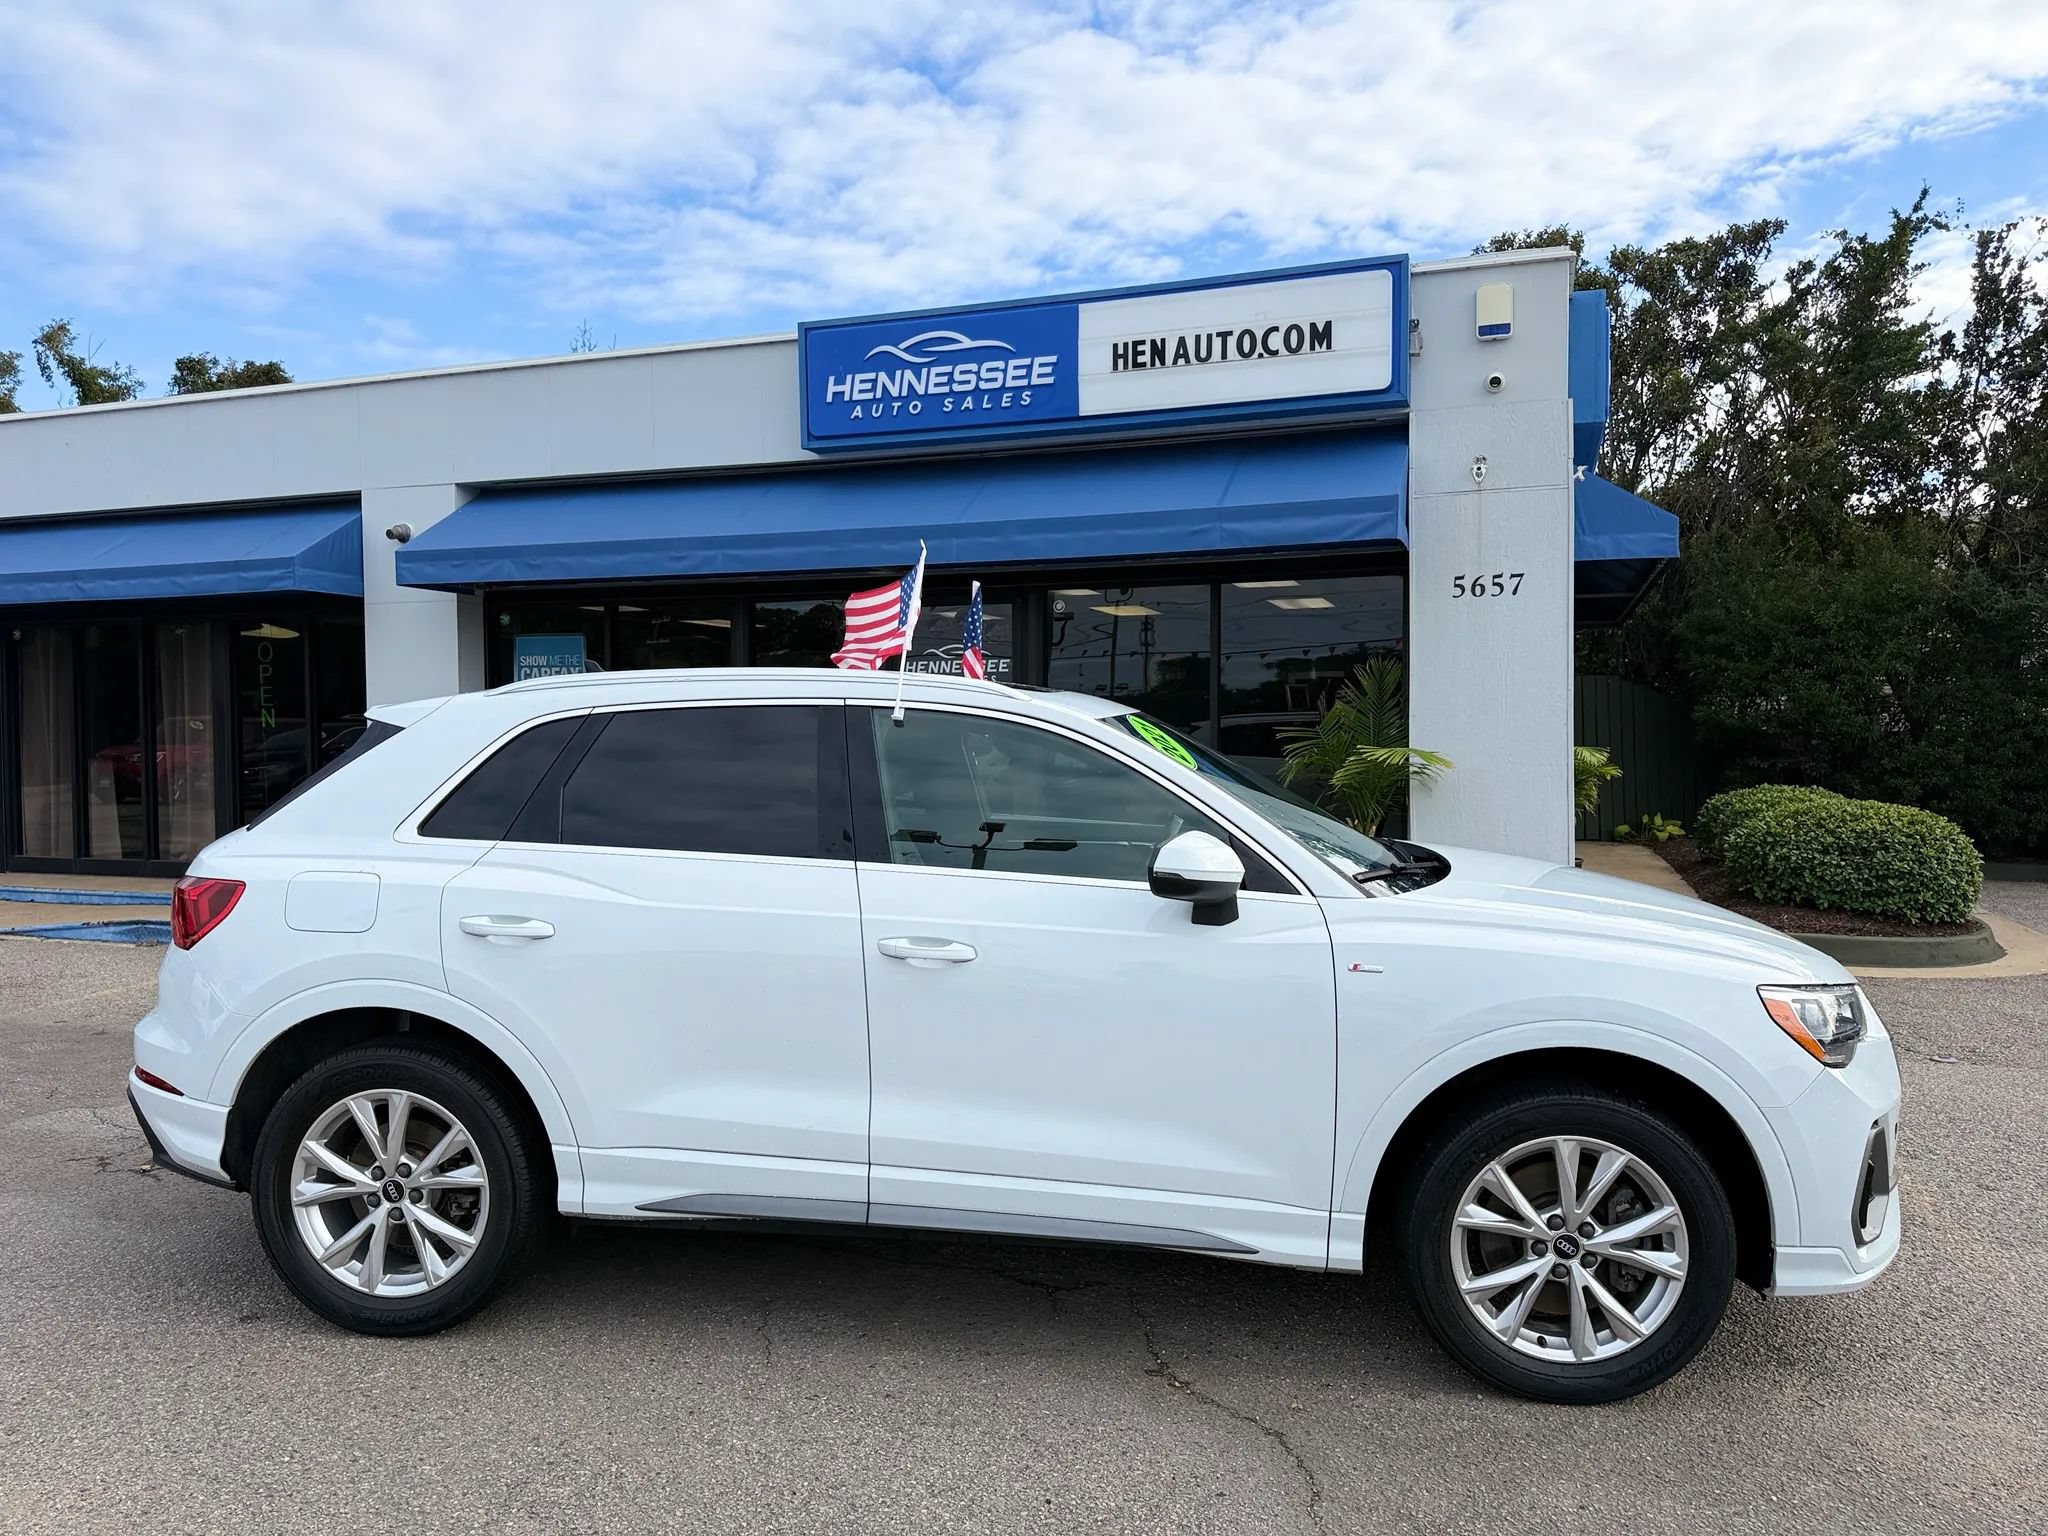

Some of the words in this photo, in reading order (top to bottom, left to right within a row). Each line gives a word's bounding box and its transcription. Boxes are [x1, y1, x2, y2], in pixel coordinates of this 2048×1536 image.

[1111, 319, 1333, 372] HENAUTO.COM
[825, 354, 1058, 403] HENNESSEE
[850, 400, 922, 420] AUTO
[942, 390, 1032, 412] SALES
[1451, 571, 1525, 599] 5657
[519, 655, 547, 667] SHOW
[549, 654, 563, 666] ME
[565, 654, 581, 666] THE
[905, 658, 1011, 674] HENNEEE
[256, 640, 276, 729] OPEN
